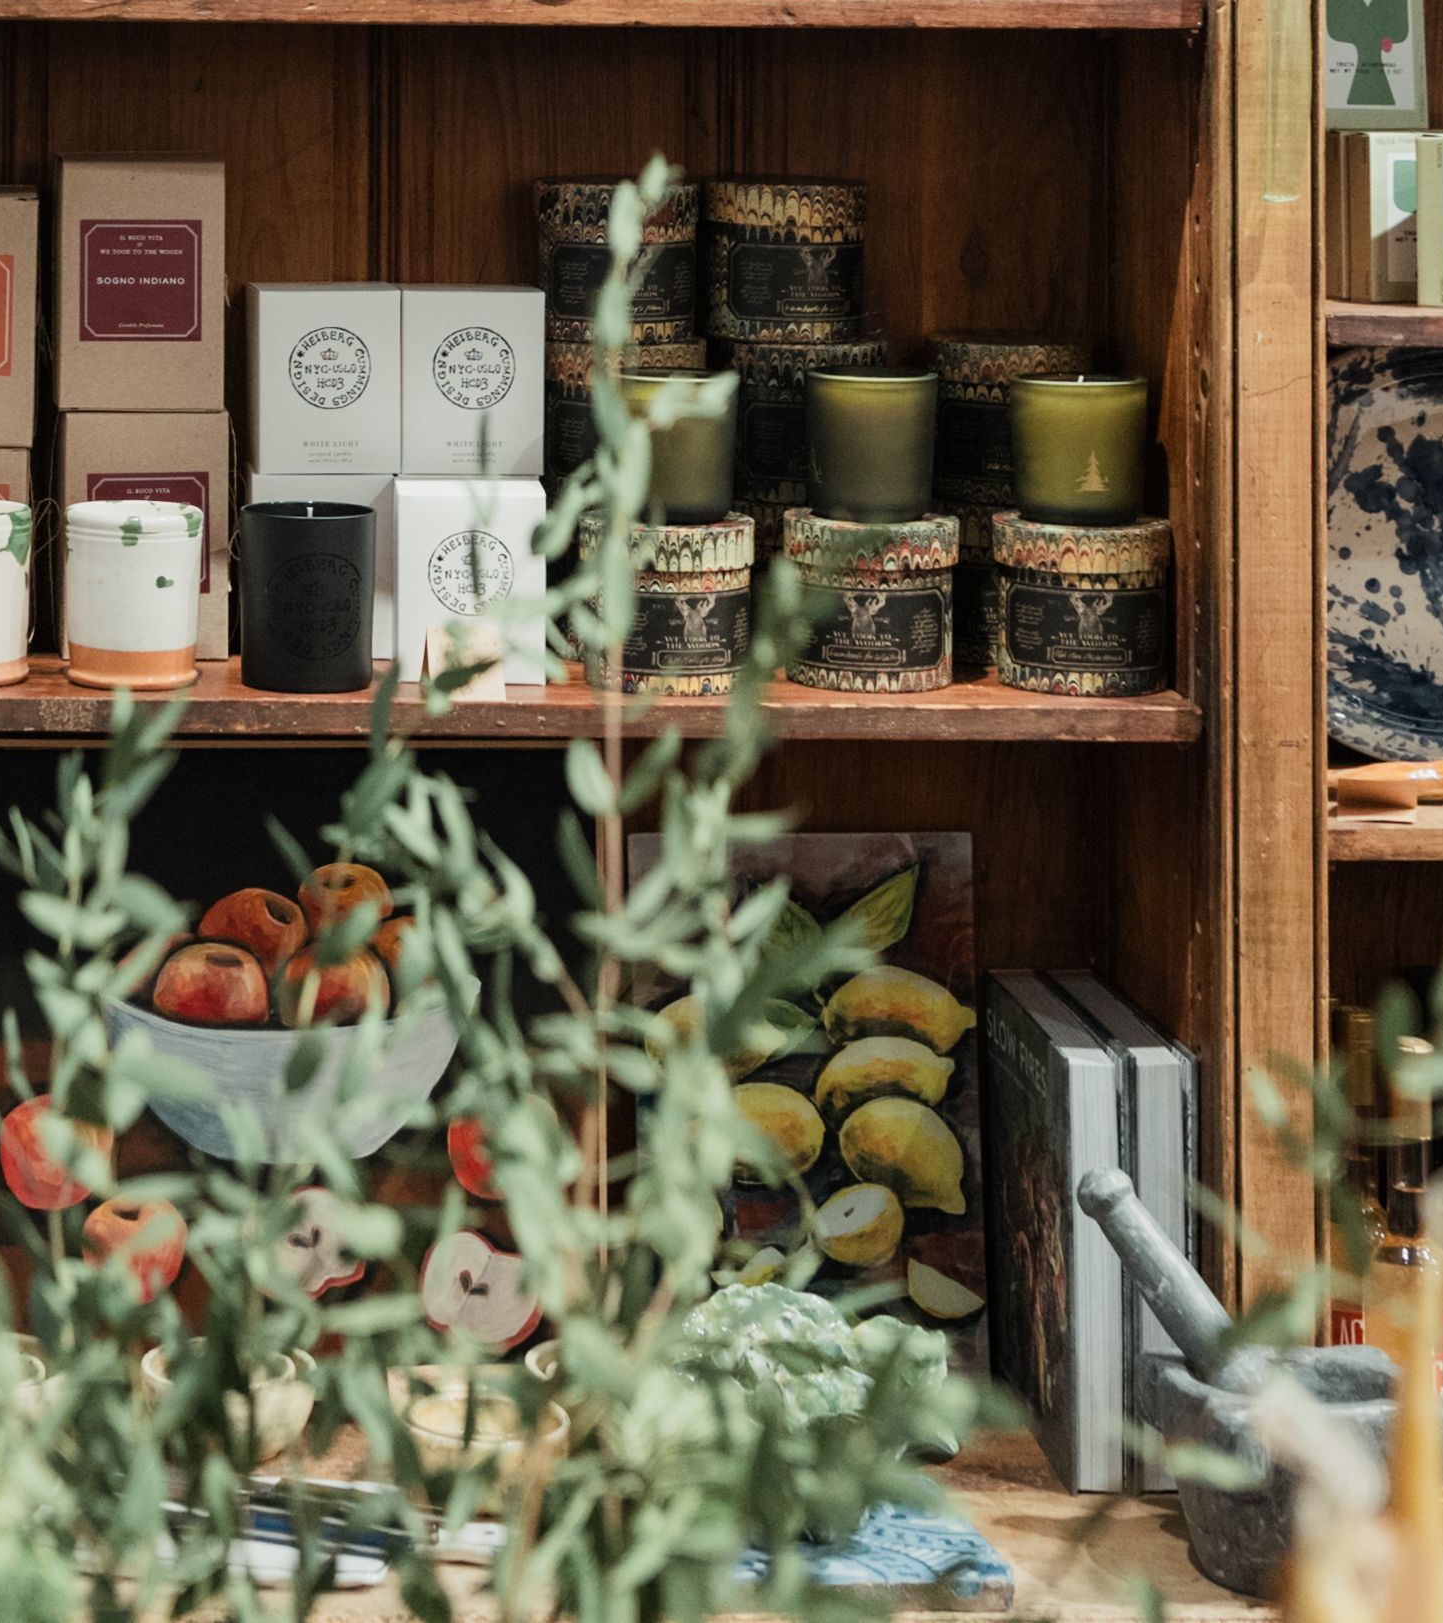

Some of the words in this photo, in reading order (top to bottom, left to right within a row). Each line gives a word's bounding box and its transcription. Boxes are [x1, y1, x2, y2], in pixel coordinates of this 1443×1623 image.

[96, 276, 136, 285] SOGNO
[139, 276, 186, 285] INDIANO
[302, 330, 355, 352] HEIBERG
[446, 330, 499, 352] HEIBERG
[293, 360, 326, 406] DESIGN
[332, 348, 367, 407] CUMMINGS
[437, 360, 470, 406] DESIGN
[476, 348, 512, 407] CUMMINGS
